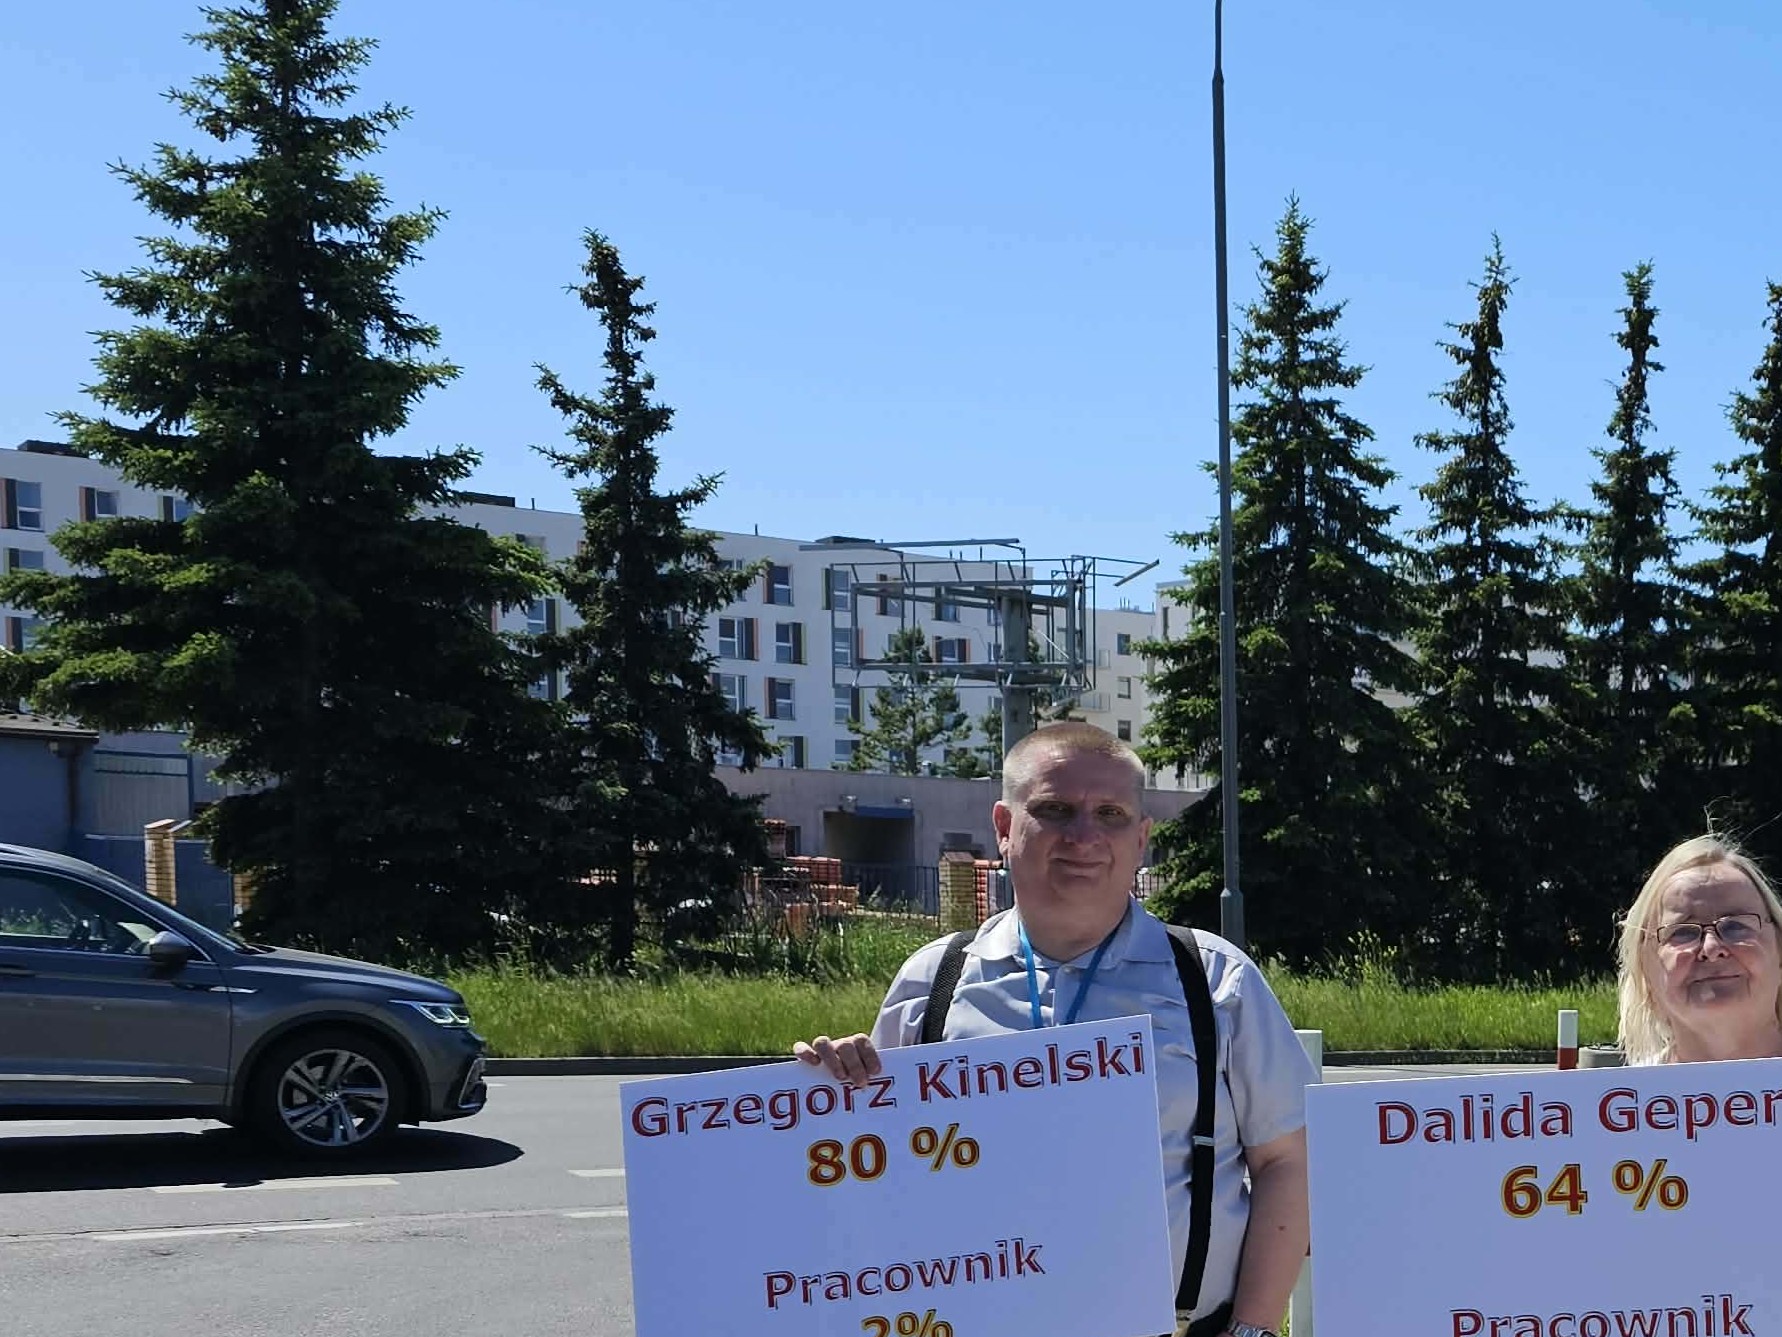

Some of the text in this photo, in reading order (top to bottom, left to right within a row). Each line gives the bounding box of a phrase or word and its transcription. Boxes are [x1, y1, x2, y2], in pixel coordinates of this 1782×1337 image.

[630, 1031, 1146, 1138] Grzegorz Kinelski
[1376, 1092, 1572, 1144] Dalida
[807, 1123, 979, 1187] 80 %
[1501, 1159, 1688, 1219] 64 %
[763, 1238, 1045, 1310] Pracownik
